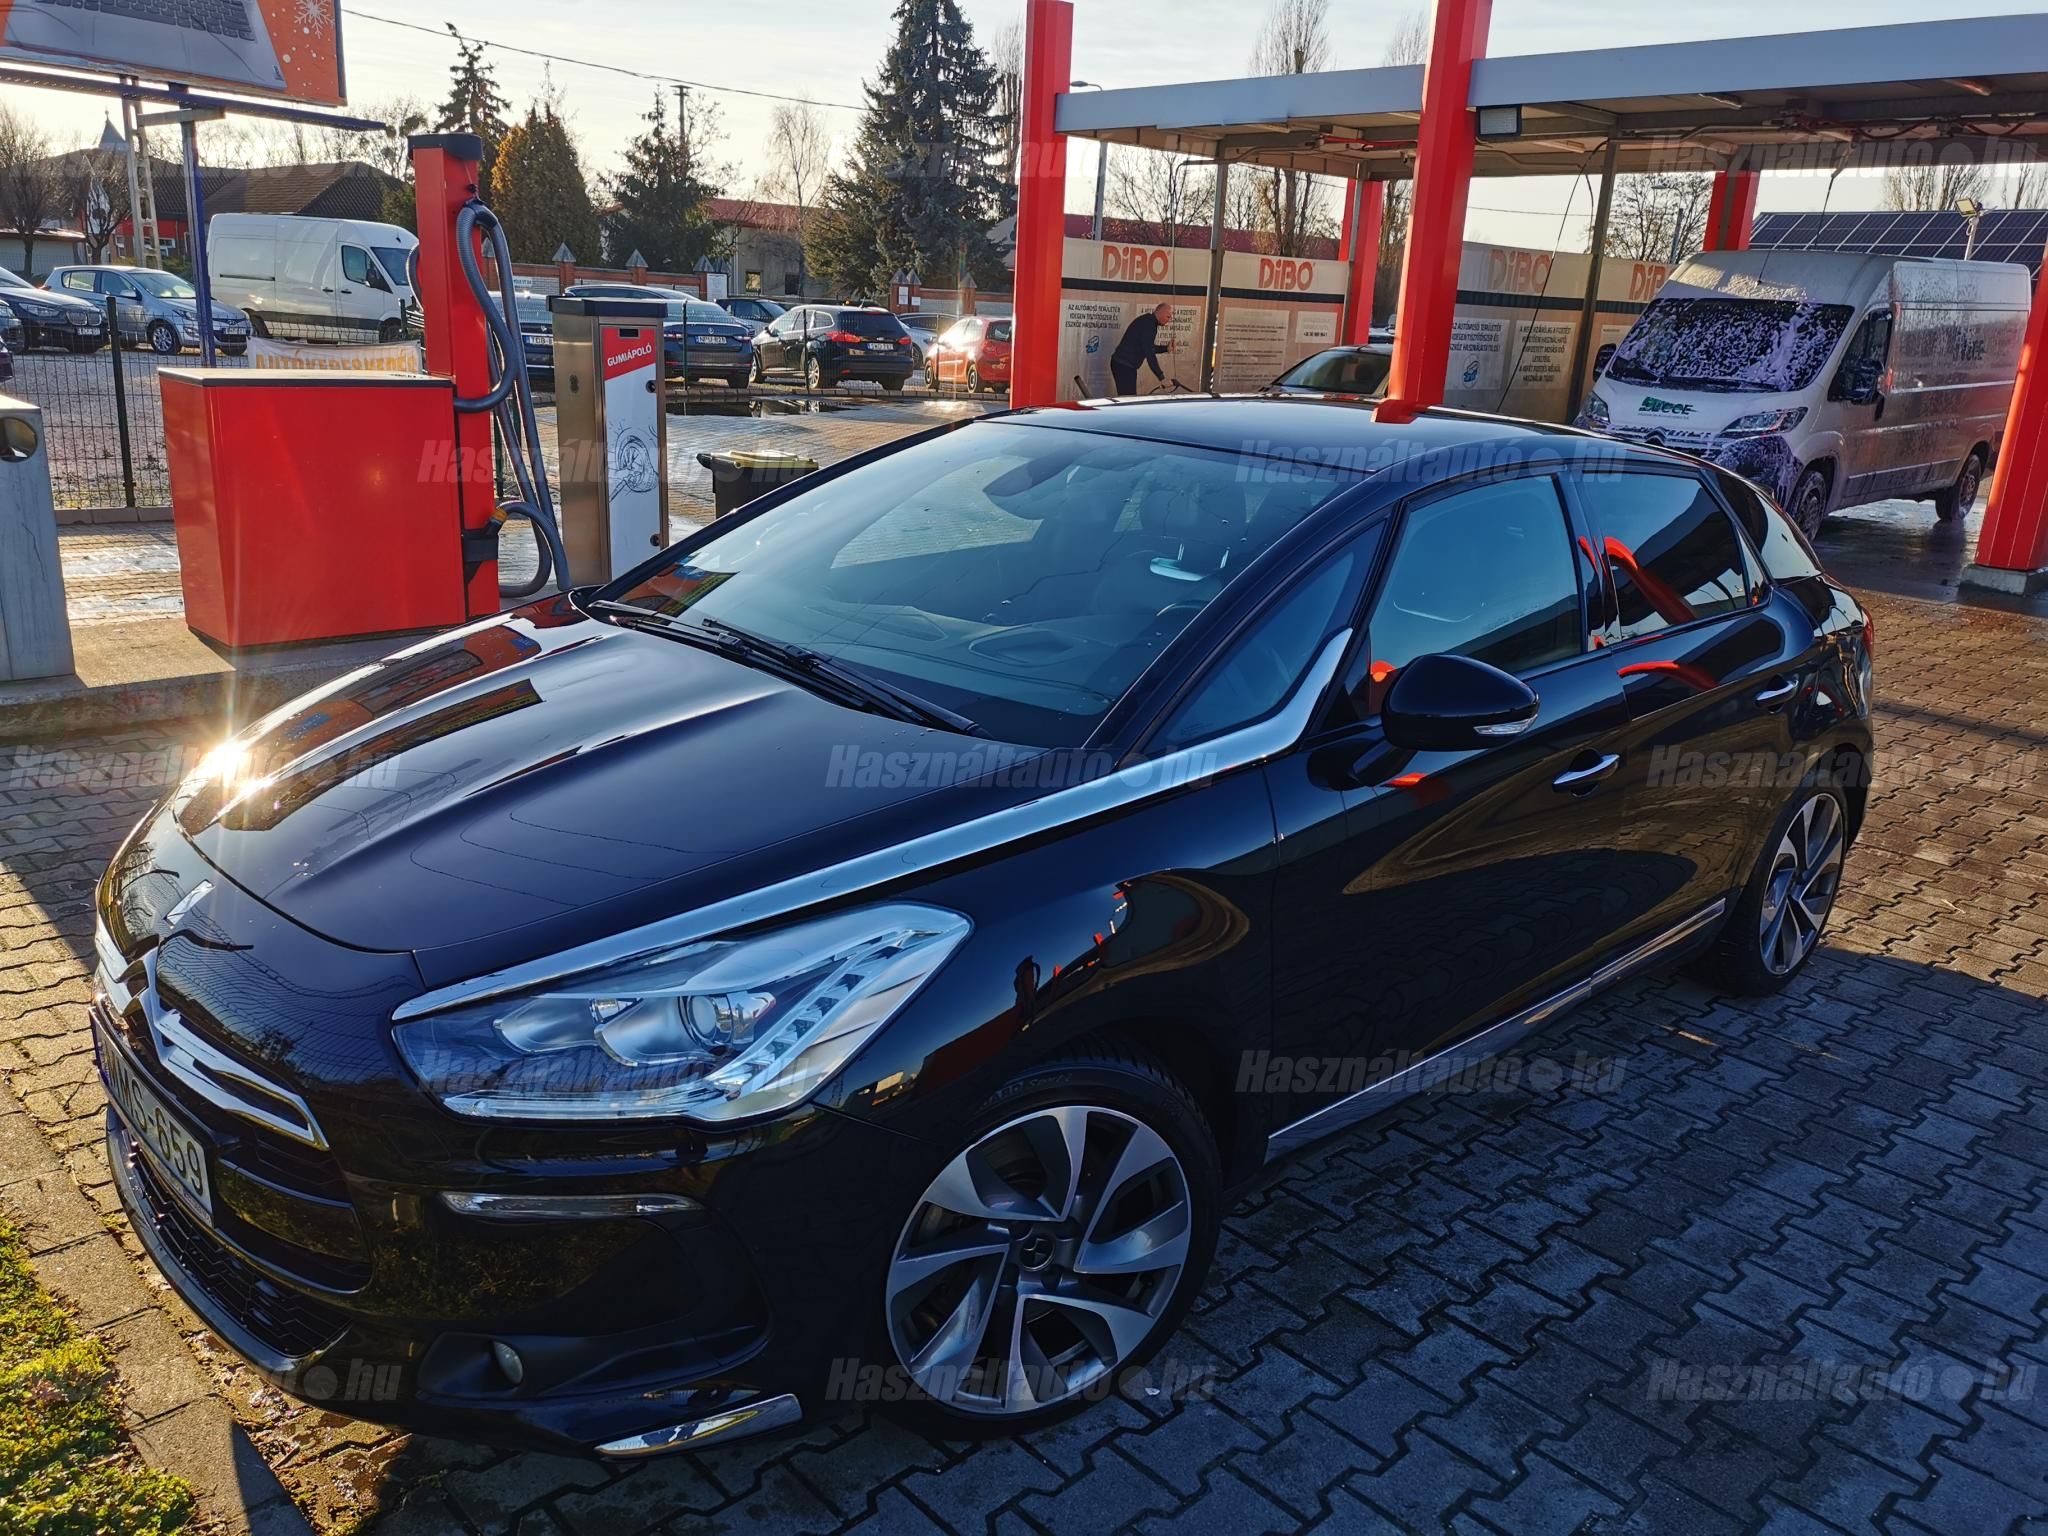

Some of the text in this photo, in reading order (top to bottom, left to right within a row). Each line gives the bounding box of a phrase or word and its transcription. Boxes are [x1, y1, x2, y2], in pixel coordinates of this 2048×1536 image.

[1101, 244, 1170, 283] DiBO
[1258, 257, 1313, 291] DiBO
[607, 342, 652, 367] GUMIÁPOLÓ
